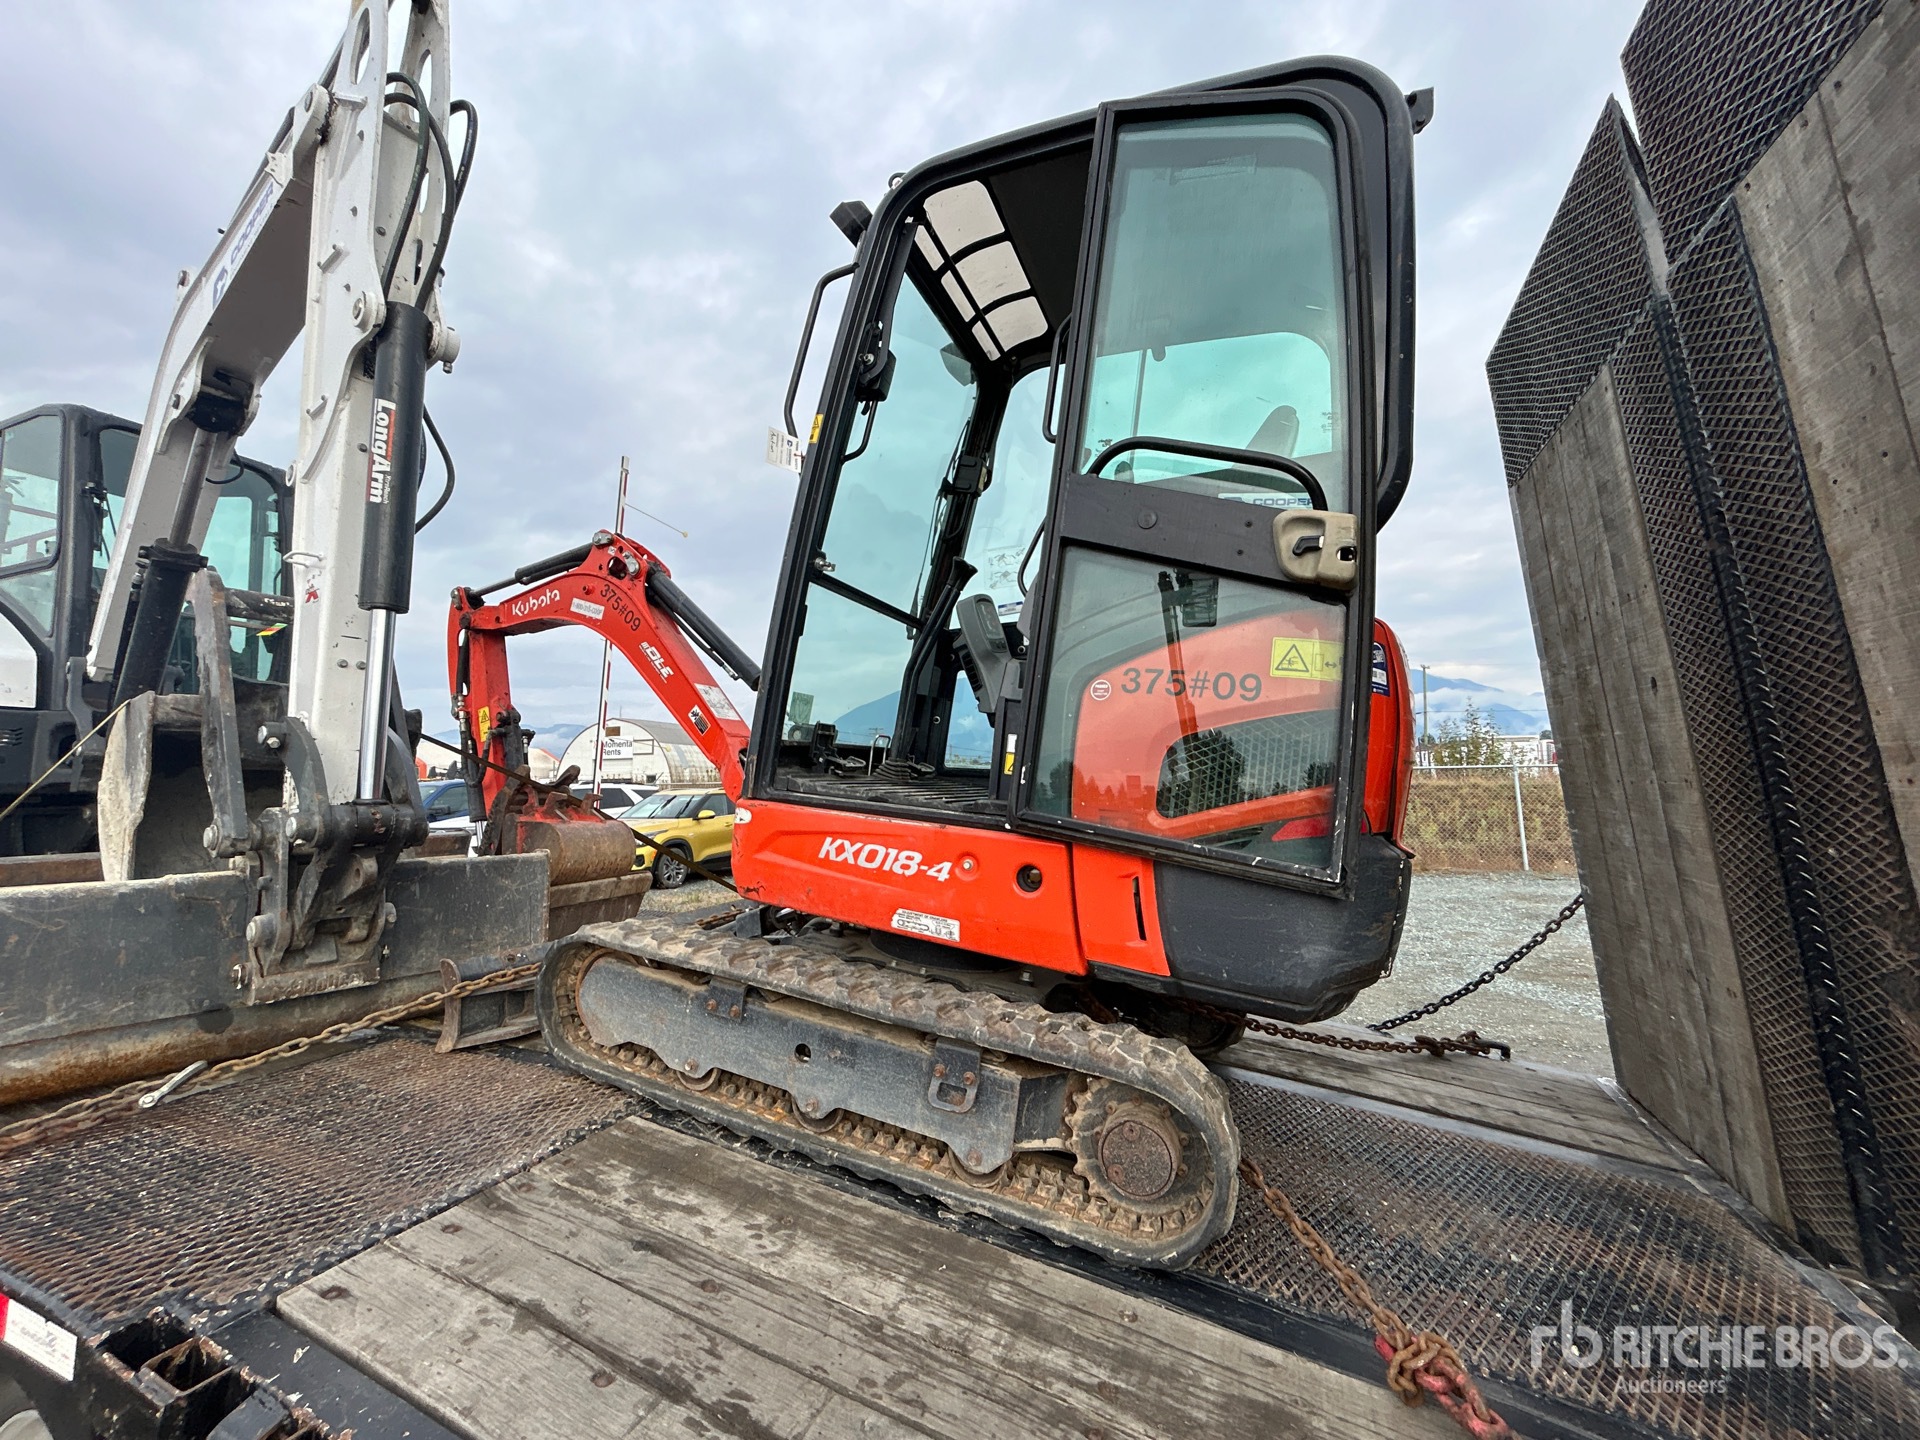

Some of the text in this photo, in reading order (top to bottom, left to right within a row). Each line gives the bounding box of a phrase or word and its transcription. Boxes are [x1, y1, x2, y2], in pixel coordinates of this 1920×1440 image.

[370, 398, 396, 503] LongArm
[512, 589, 560, 616] Kubota
[600, 583, 641, 632] 375#09
[1121, 668, 1262, 702] 375#09
[818, 836, 953, 882] KX018-4
